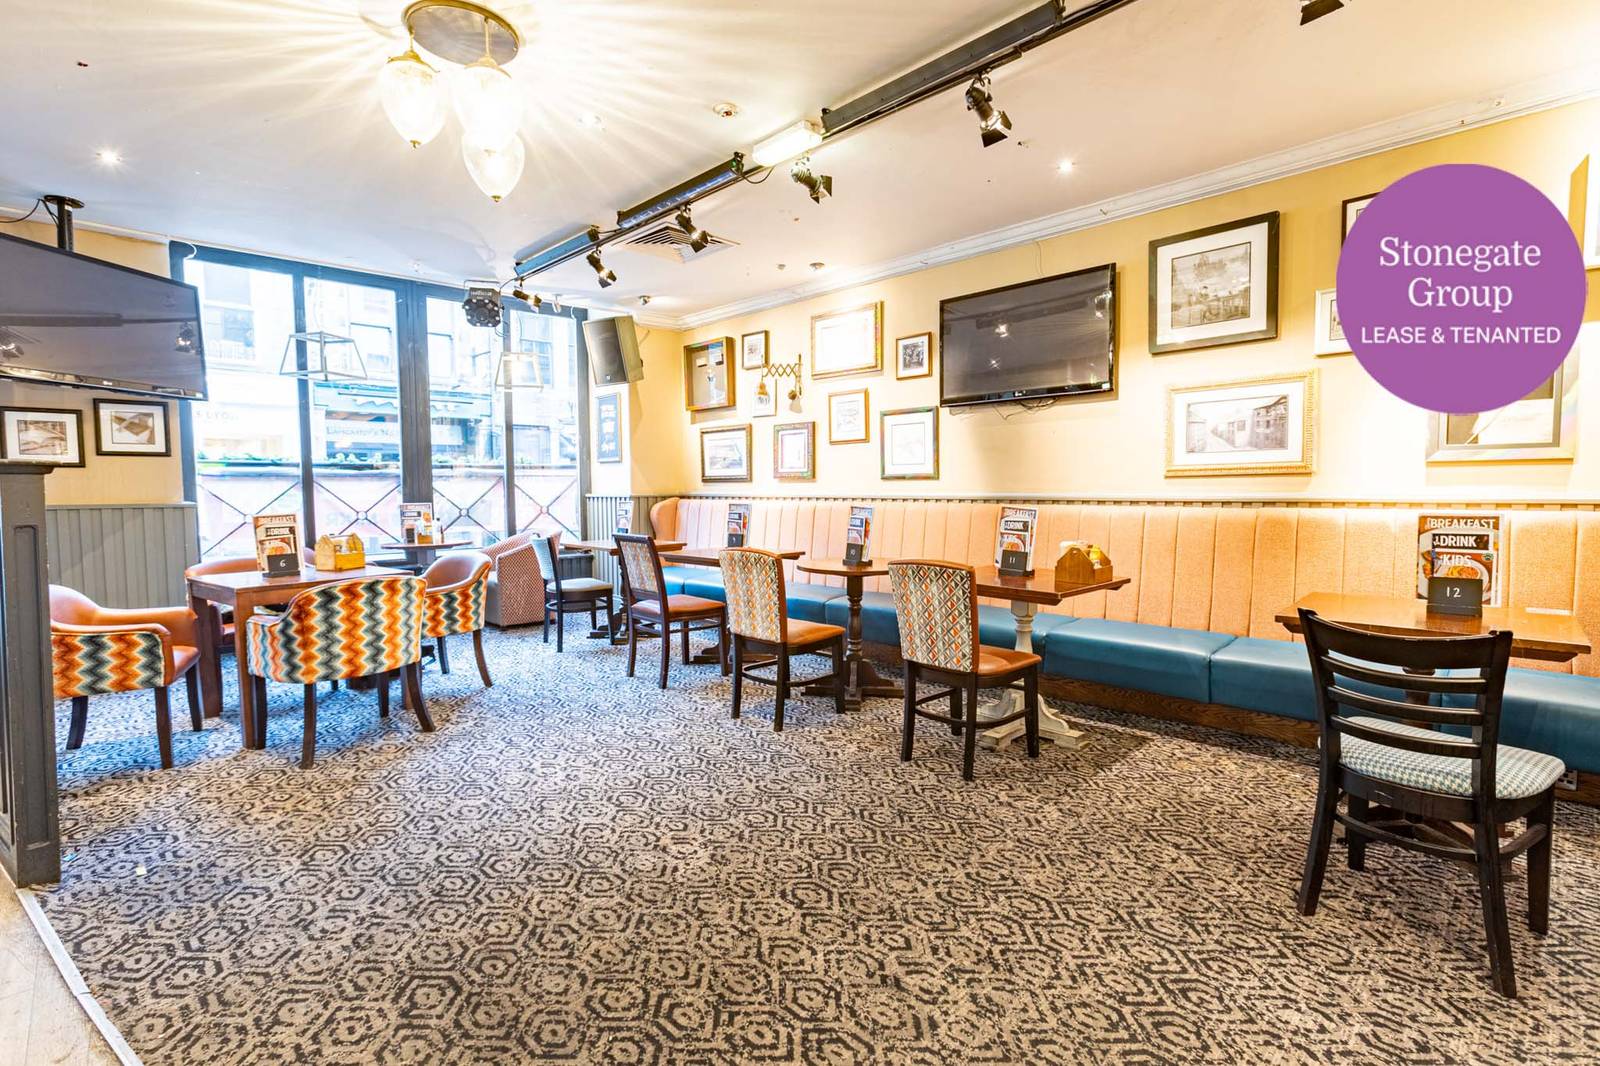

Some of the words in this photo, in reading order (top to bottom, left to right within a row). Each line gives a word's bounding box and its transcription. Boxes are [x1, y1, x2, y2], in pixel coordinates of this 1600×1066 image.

[1430, 518, 1496, 529] BREAKFAST
[1440, 535, 1477, 547] DRINK
[279, 559, 286, 567] 6
[1009, 556, 1016, 564] 11
[1443, 554, 1472, 567] KIDS
[1446, 586, 1461, 597] 12
